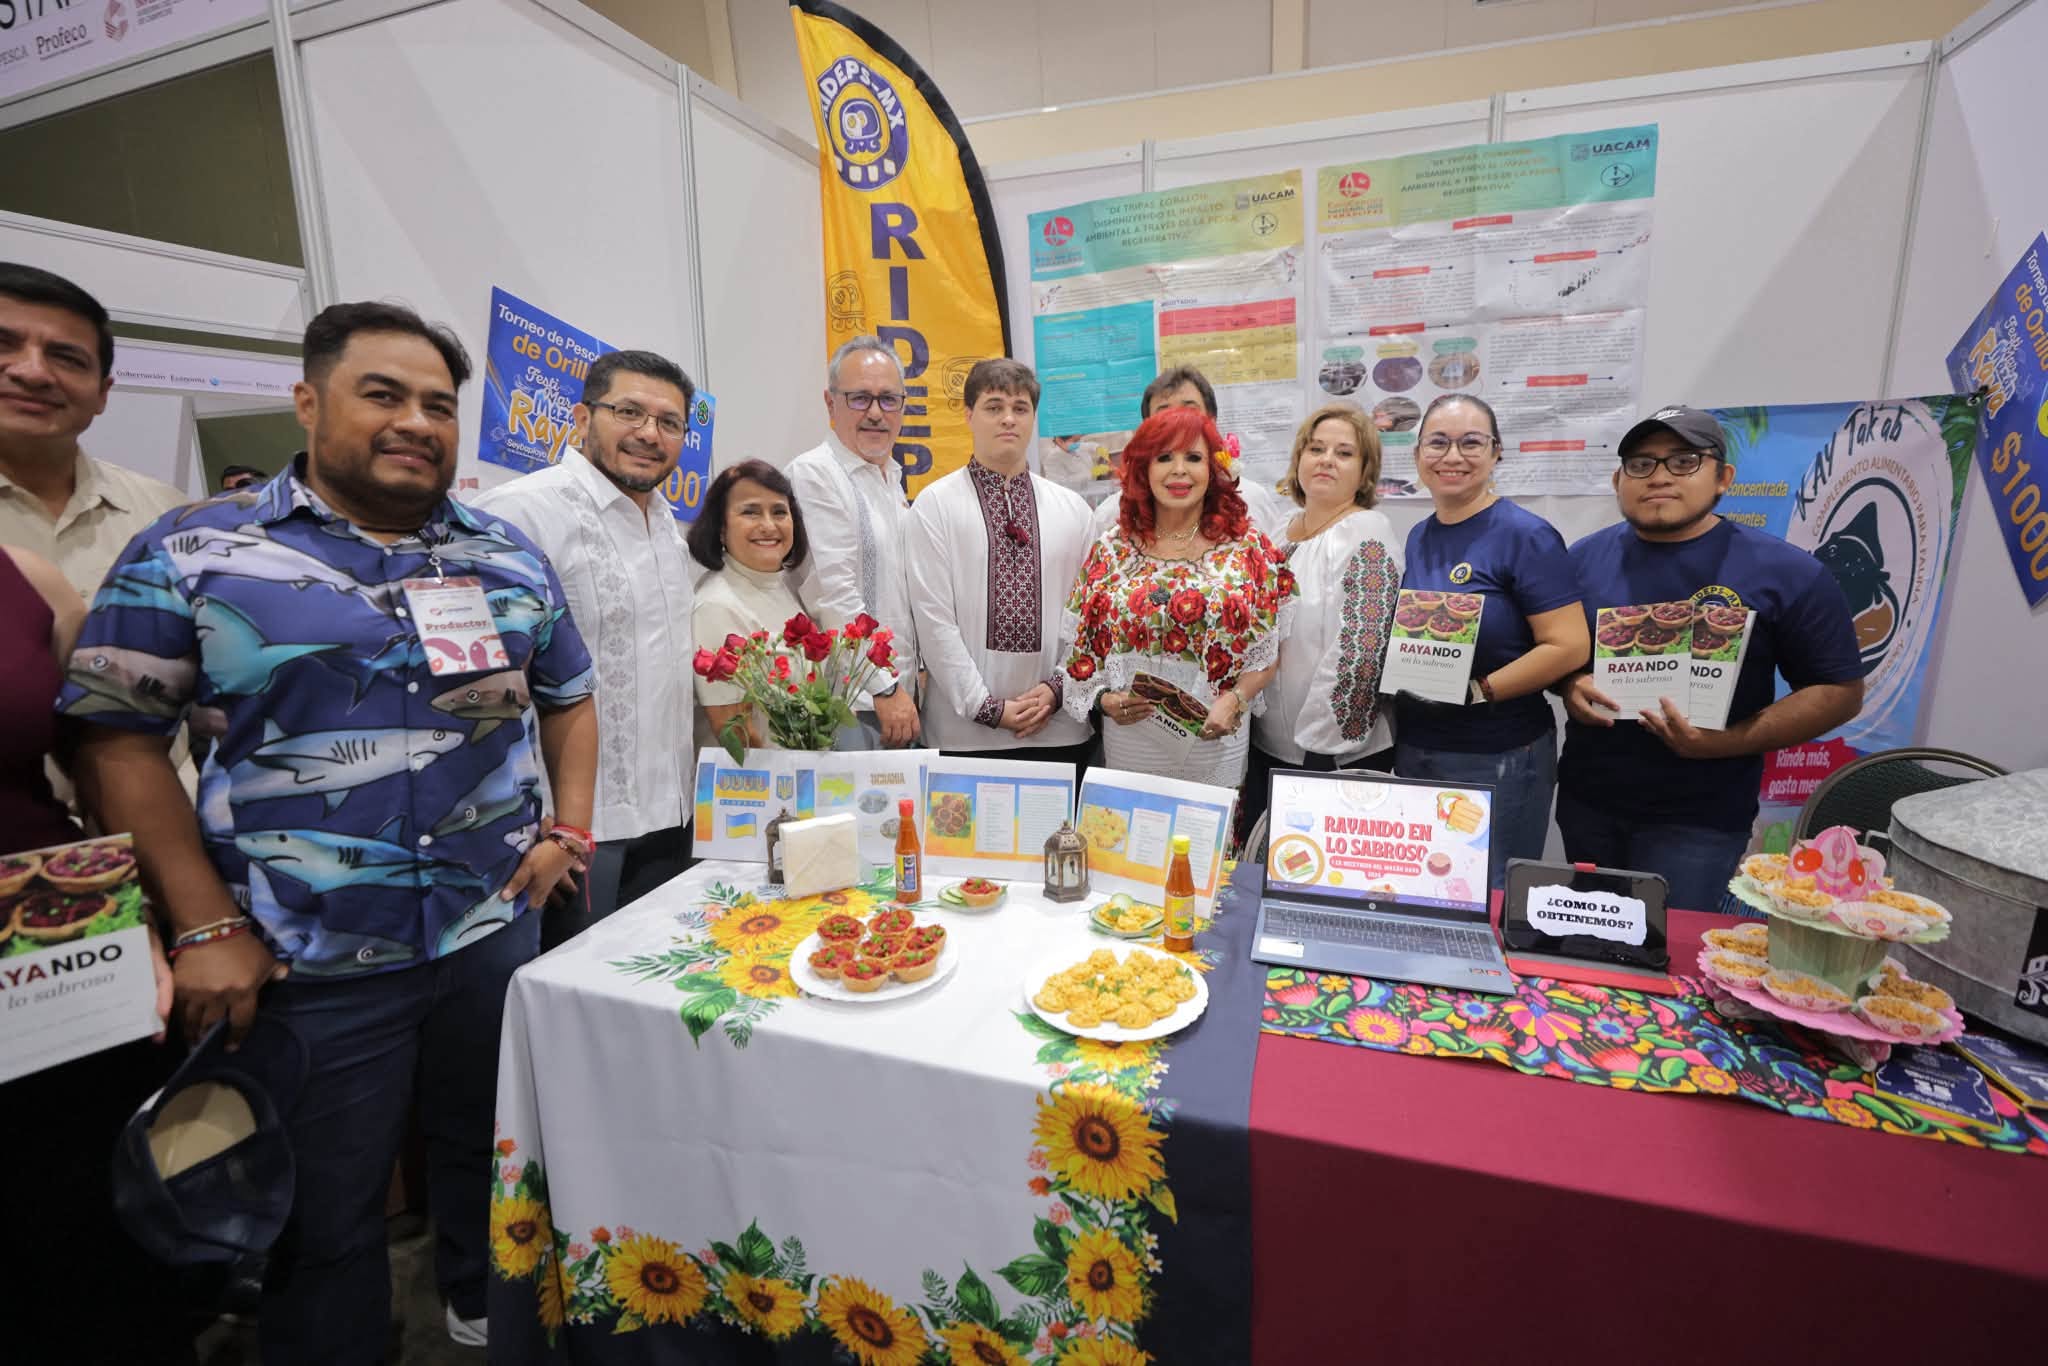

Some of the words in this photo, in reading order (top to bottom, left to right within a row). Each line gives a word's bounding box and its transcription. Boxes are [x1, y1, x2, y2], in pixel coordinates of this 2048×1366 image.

[35, 23, 88, 55] Profeco
[1591, 138, 1651, 154] UACAM
[1252, 188, 1295, 203] UACAM
[2026, 250, 2048, 297] Torneo
[2015, 283, 2033, 313] de
[498, 303, 545, 338] Torneo
[547, 330, 565, 347] de
[511, 333, 542, 361] de
[544, 346, 589, 381] Orill
[1811, 457, 1871, 538] COMPLEMENTO
[1399, 642, 1462, 659] RAYANDO
[1421, 657, 1455, 670] sabroso
[1607, 659, 1679, 674] RAYANDO
[1611, 677, 1623, 685] en
[1635, 674, 1673, 685] sabroso
[1152, 714, 1187, 738] ANDO
[1775, 747, 1806, 769] Rinde
[1806, 744, 1832, 769] más,
[1767, 776, 1798, 800] gasta
[1324, 815, 1405, 839] RAYANDO
[1408, 823, 1432, 841] EN
[1325, 835, 1347, 855] LO
[1350, 838, 1428, 862] SABROSO
[1547, 897, 1598, 912] ¿COMO
[1601, 903, 1621, 914] LO
[1537, 910, 1634, 931] OBTENEMOS?
[0, 944, 123, 991] YANDO
[7, 993, 29, 1011] lo
[33, 971, 116, 1001] sabroso
